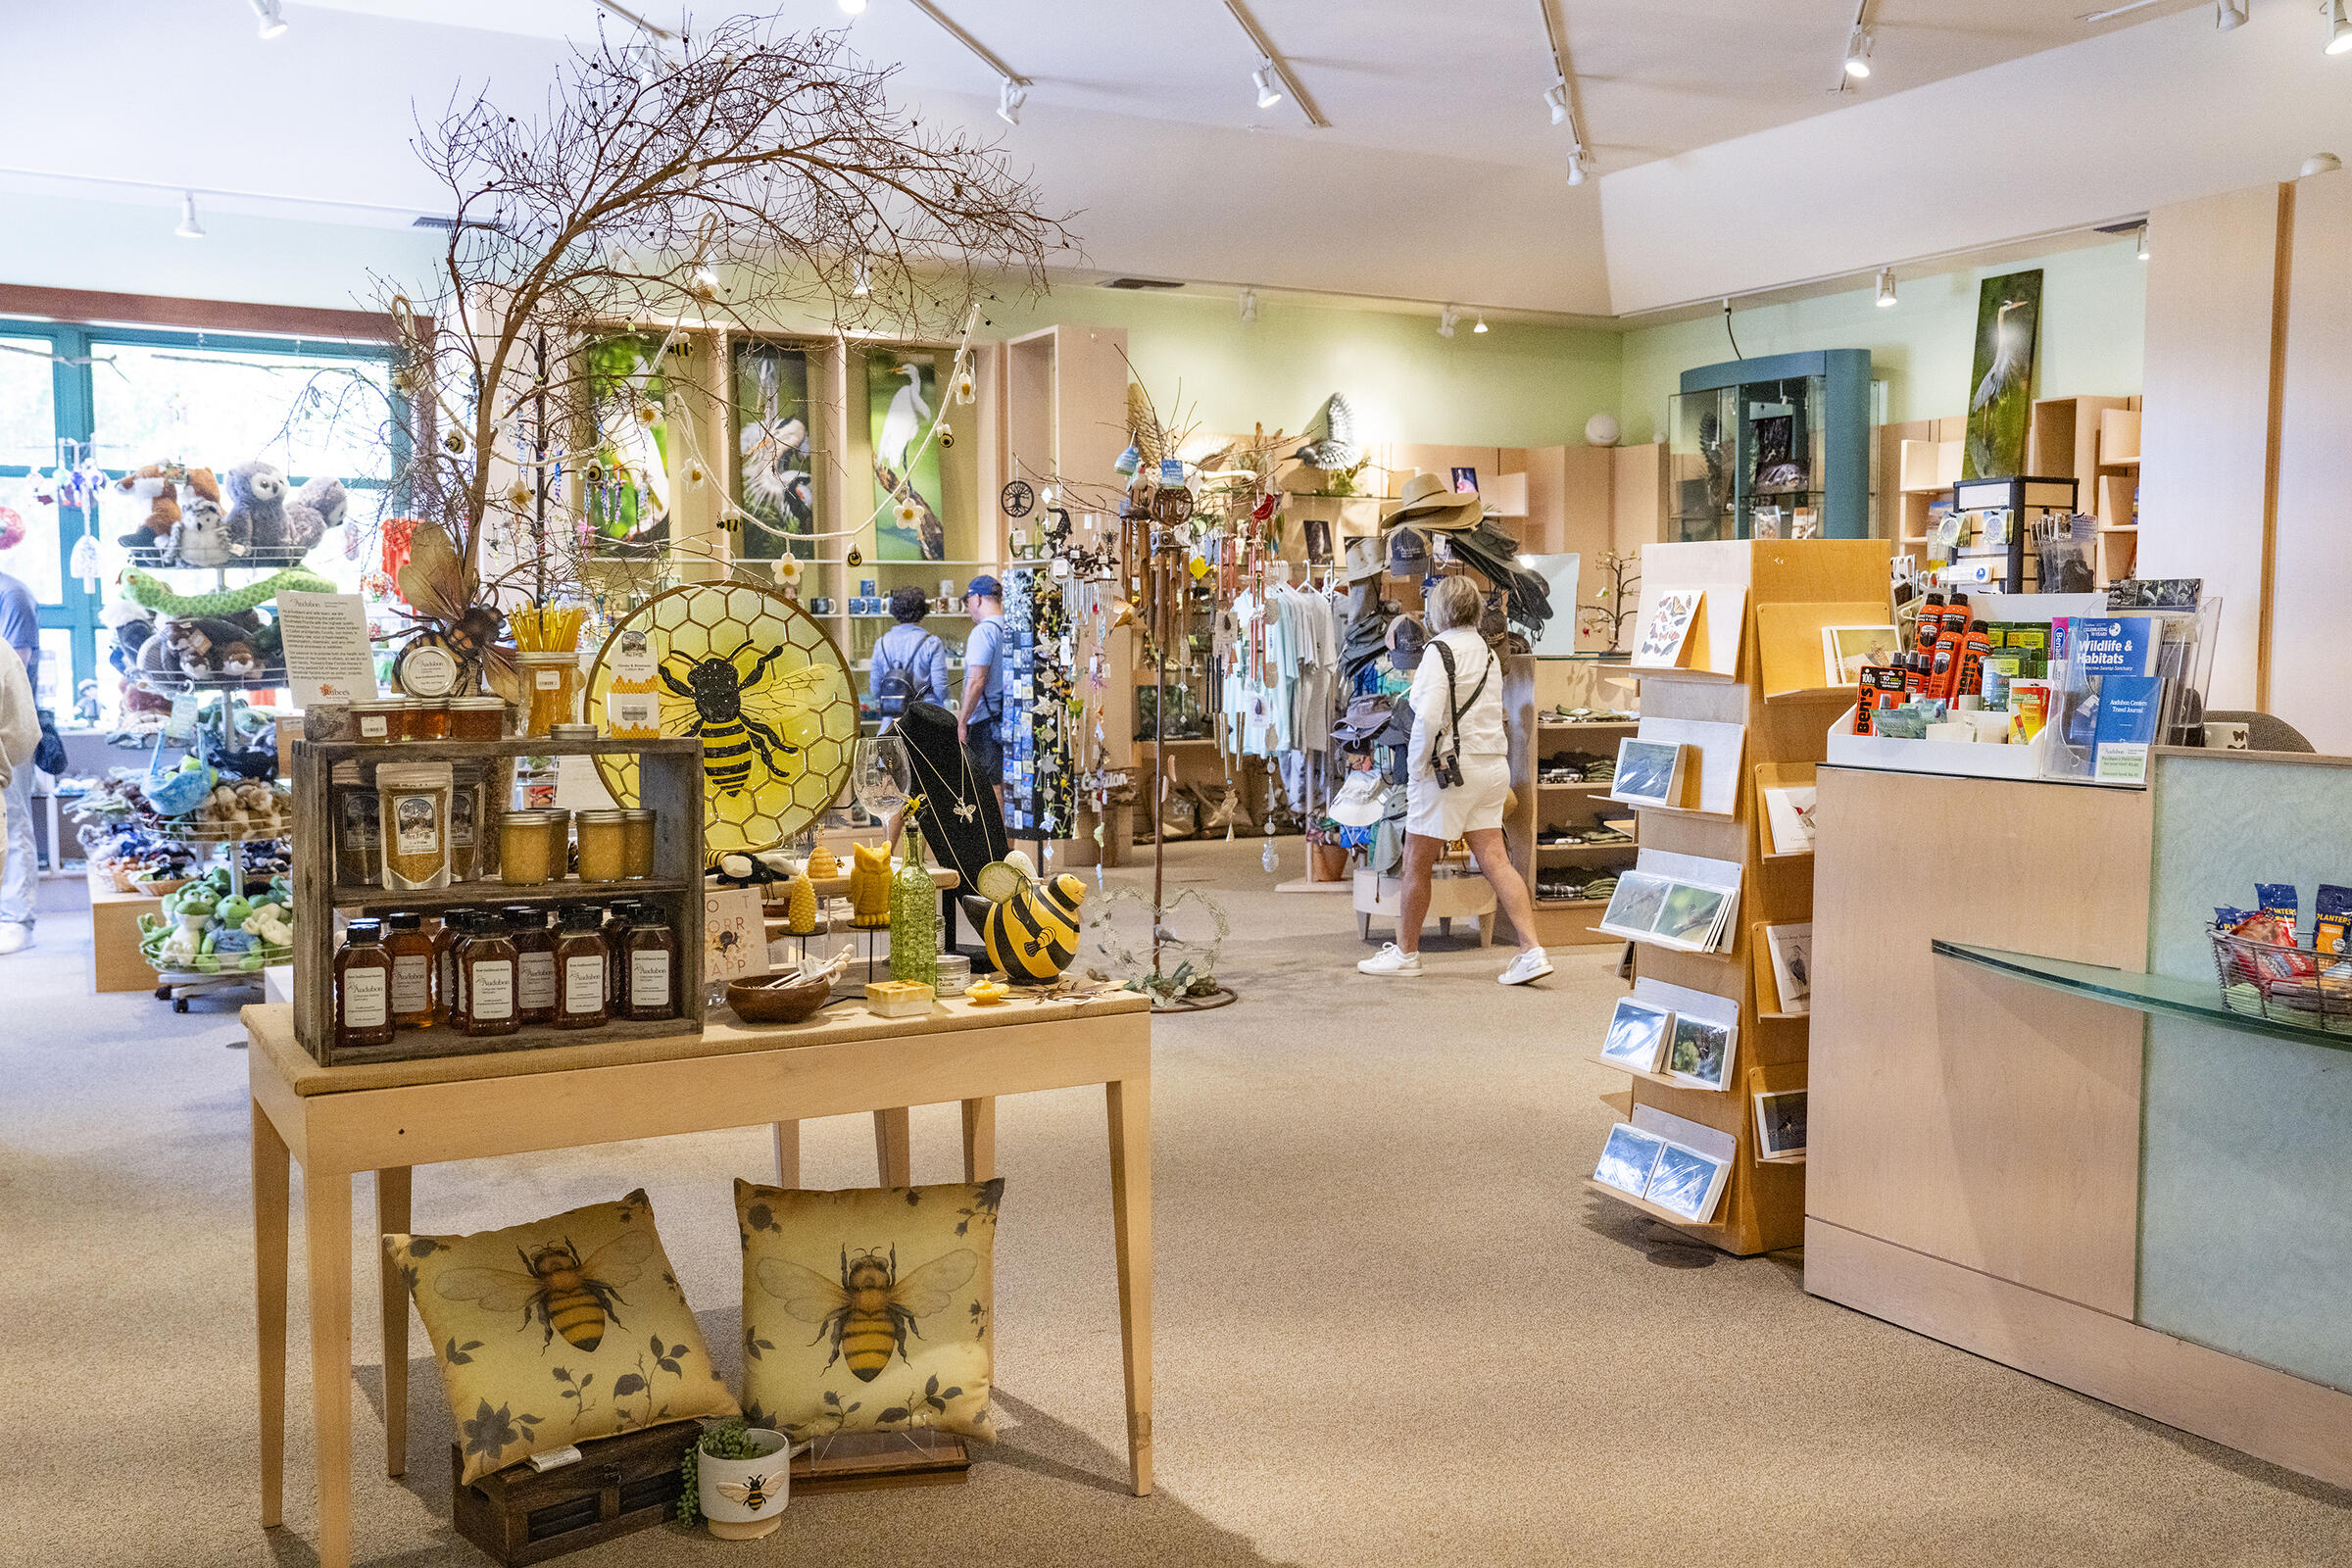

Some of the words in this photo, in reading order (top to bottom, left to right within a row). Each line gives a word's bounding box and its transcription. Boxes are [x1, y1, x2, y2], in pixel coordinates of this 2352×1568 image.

[2079, 640, 2122, 652] Wildlife
[2124, 640, 2133, 651] &
[2077, 652, 2124, 664] Habitats
[1984, 673, 1993, 712] atrapel
[1858, 687, 1873, 733] Ben's
[2317, 913, 2352, 925] PLANTERS
[353, 983, 383, 993] Audubon
